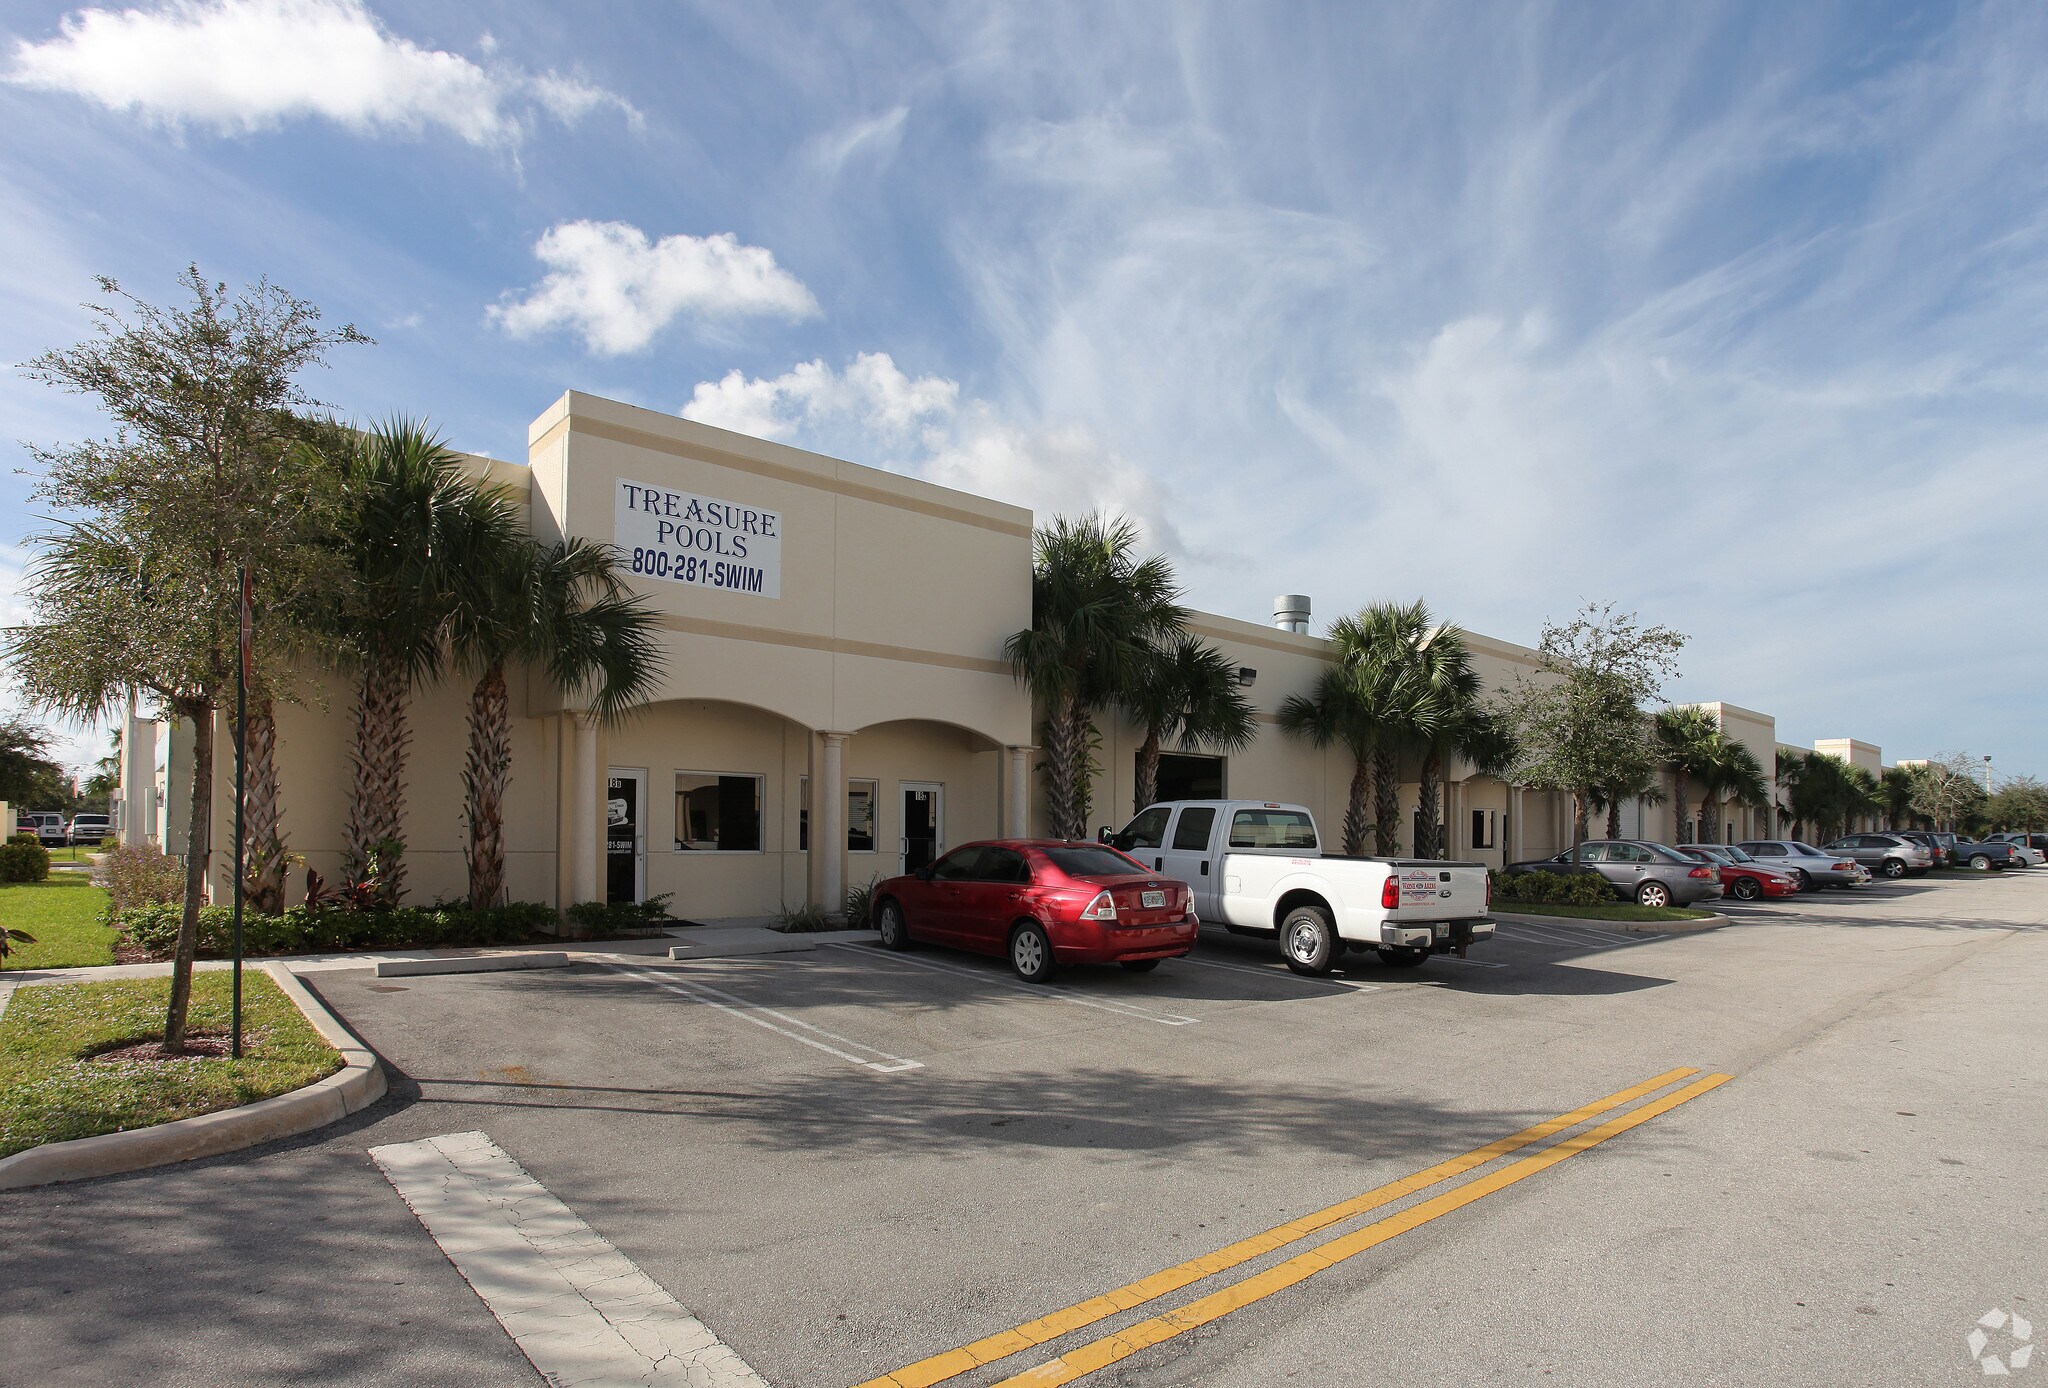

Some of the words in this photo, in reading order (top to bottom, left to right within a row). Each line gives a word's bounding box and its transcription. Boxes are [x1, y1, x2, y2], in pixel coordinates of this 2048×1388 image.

[622, 484, 777, 538] TREASURE
[656, 520, 748, 559] POOLS
[632, 546, 764, 593] 800-281-SWIM
